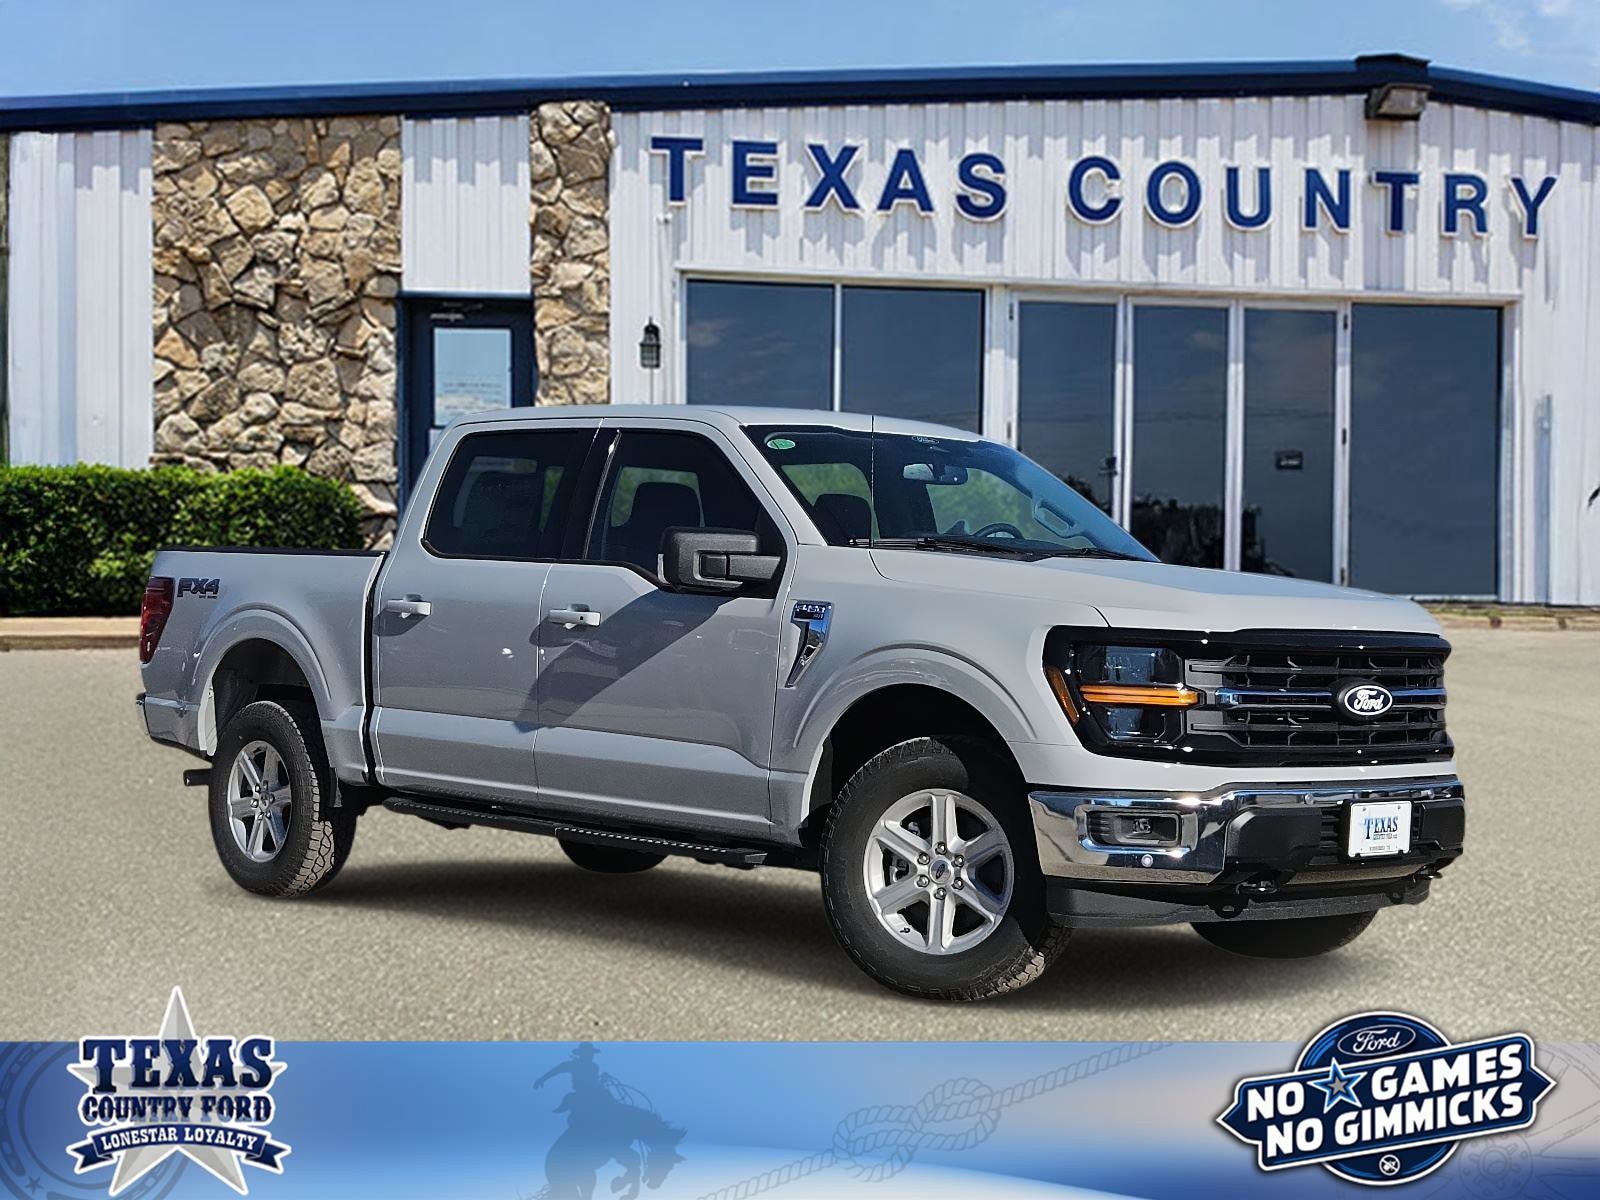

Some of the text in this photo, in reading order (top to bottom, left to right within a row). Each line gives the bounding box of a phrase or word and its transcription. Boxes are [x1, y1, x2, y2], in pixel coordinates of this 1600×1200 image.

[650, 136, 1557, 239] TEXAS COUNTRY
[177, 577, 220, 597] FX4
[1353, 688, 1385, 711] Ford
[1364, 815, 1398, 839] TEXAS
